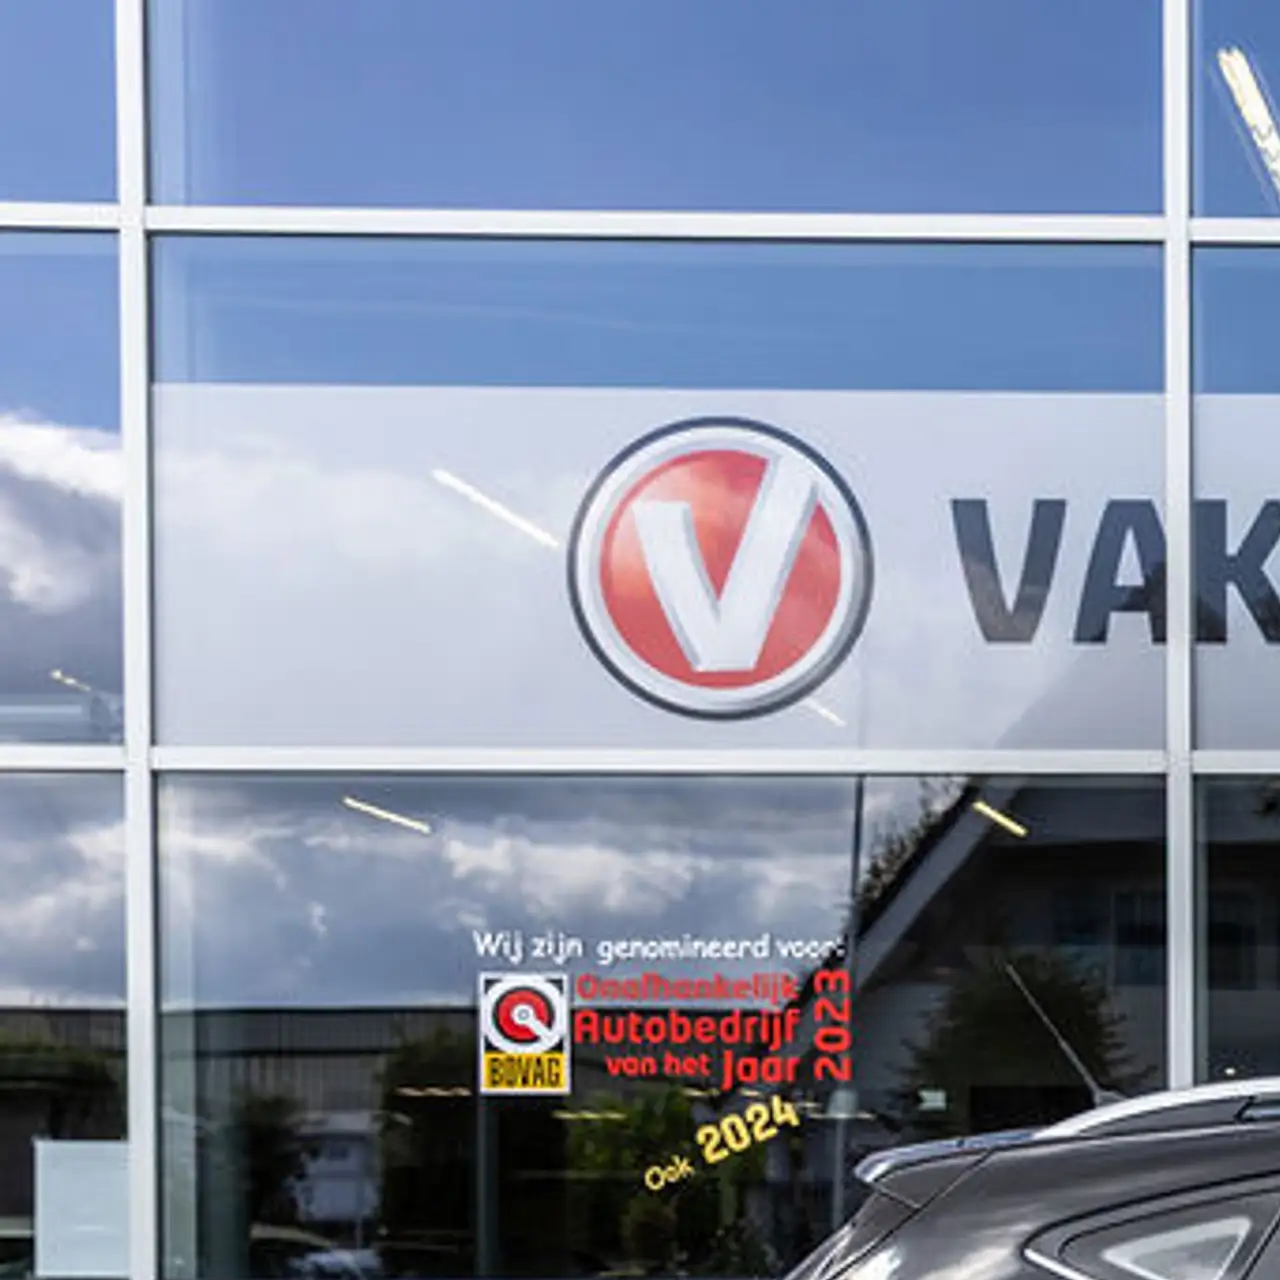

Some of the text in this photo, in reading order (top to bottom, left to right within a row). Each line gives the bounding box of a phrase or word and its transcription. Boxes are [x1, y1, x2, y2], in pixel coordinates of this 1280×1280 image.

[473, 930, 524, 964] Wij
[531, 931, 584, 965] zijn
[597, 932, 771, 965] genomineerd
[573, 1008, 801, 1051] Autobedrijf
[813, 968, 853, 1082] 2023
[486, 1057, 562, 1088] BOVAG
[605, 1056, 658, 1077] van
[663, 1051, 712, 1077] het
[644, 1094, 800, 1192] Ook 2024
